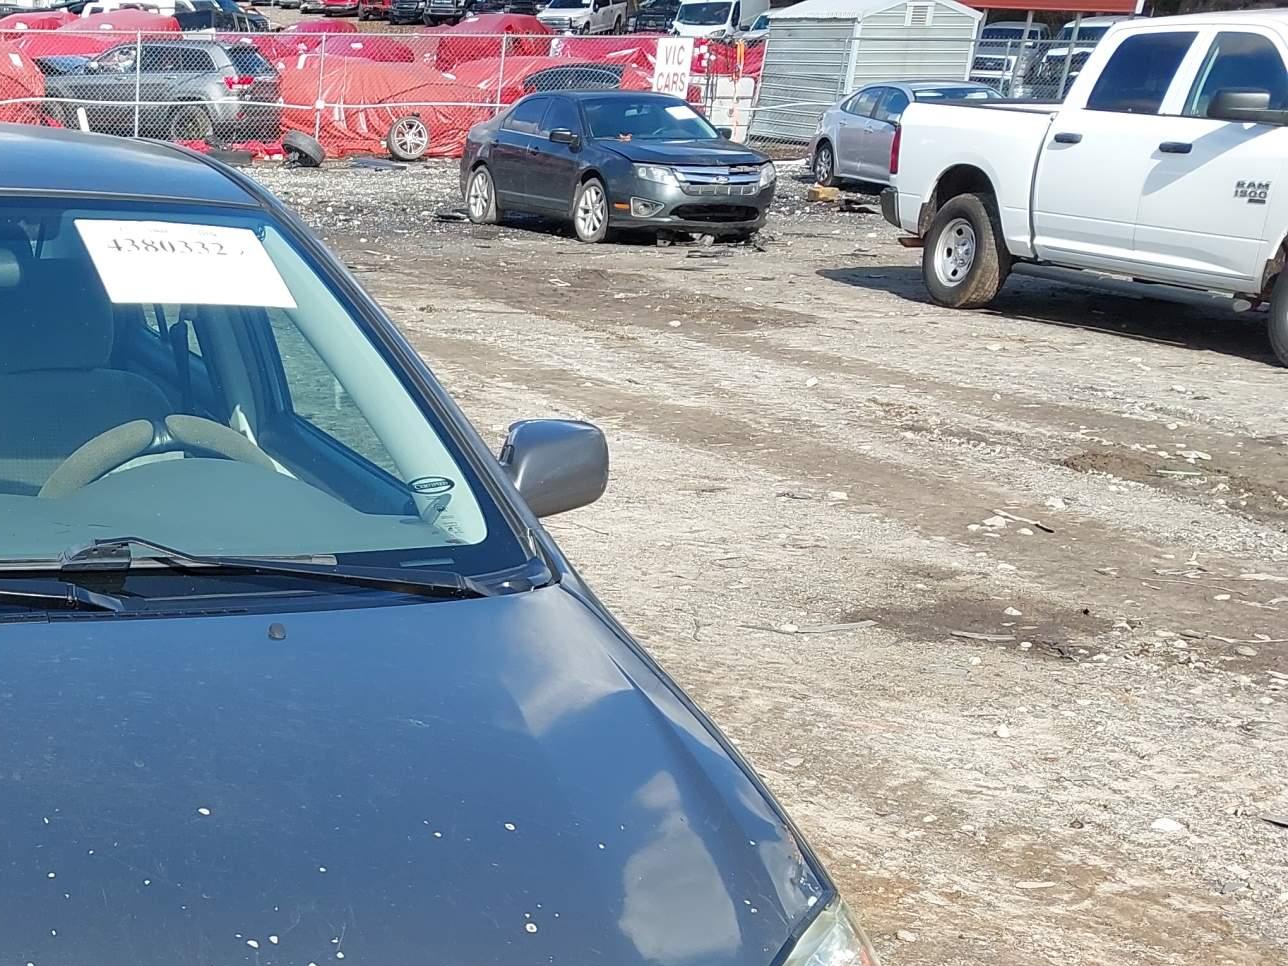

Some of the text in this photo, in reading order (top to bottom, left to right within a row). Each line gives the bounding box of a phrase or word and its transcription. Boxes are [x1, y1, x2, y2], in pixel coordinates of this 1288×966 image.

[665, 45, 685, 65] VIC
[656, 72, 686, 92] CARS
[1234, 189, 1267, 199] 1500
[1236, 180, 1270, 190] RAM
[107, 237, 246, 257] 4380332
